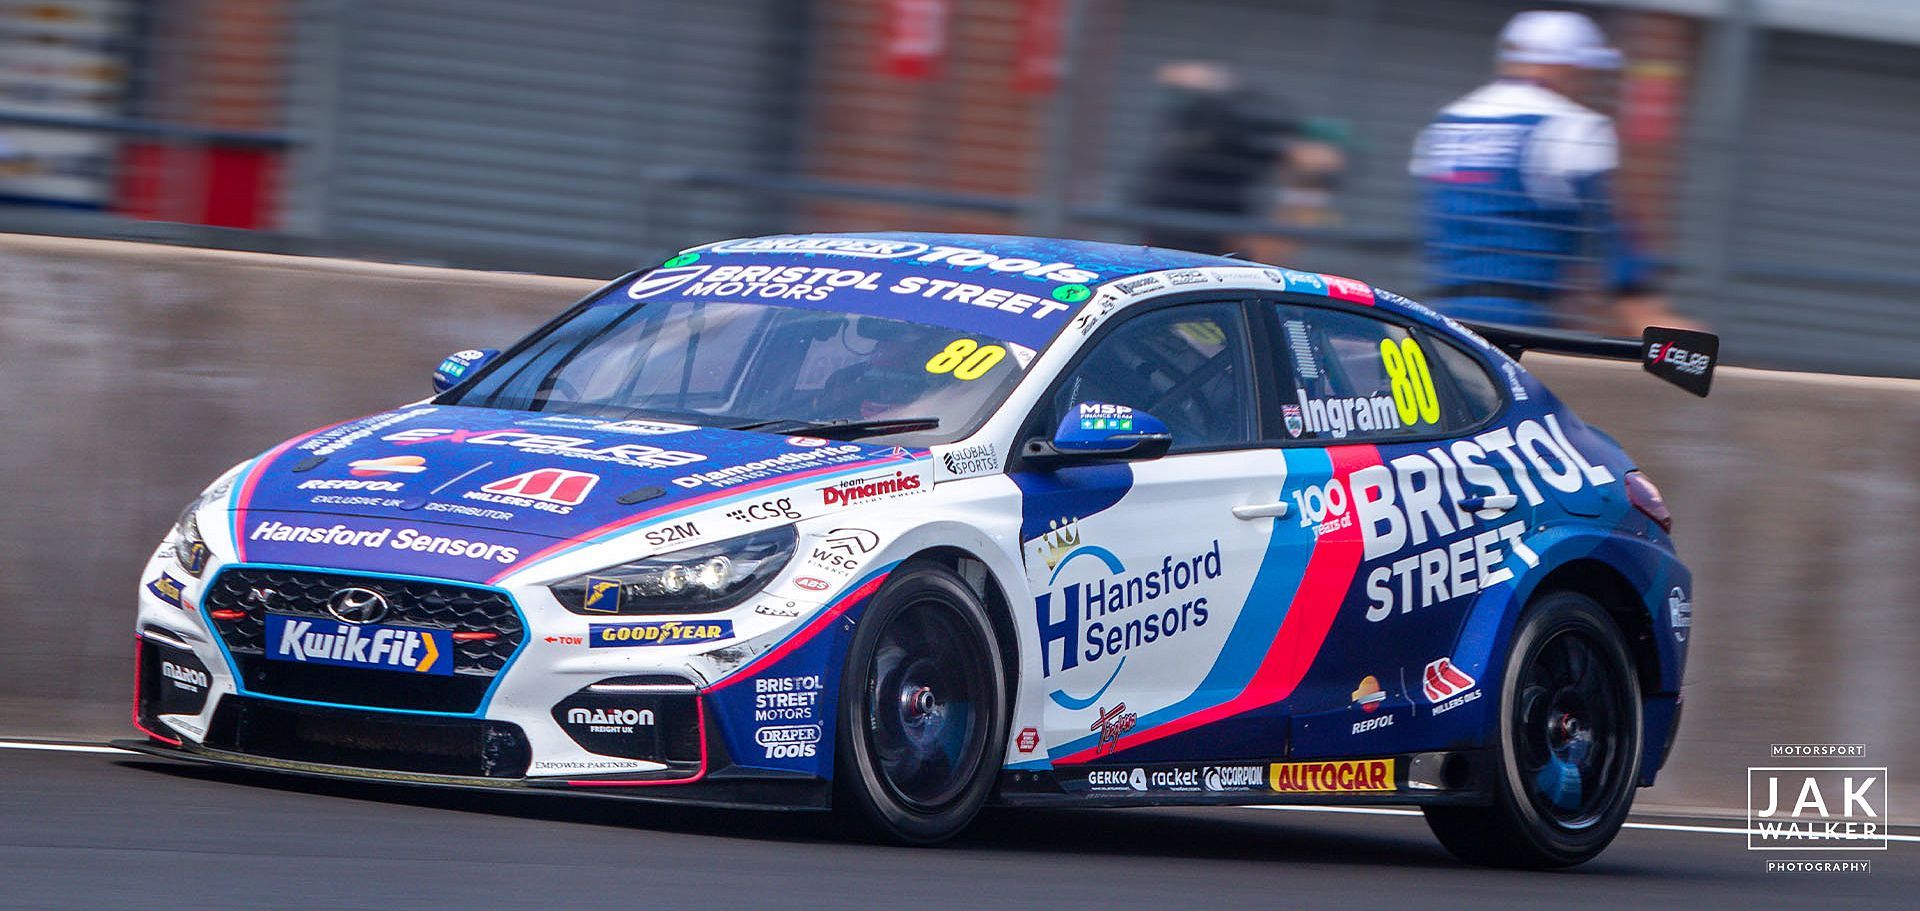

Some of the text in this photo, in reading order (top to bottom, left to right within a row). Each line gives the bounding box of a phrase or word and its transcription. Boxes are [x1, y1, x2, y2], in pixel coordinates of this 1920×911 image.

[917, 246, 1100, 283] Tools
[682, 282, 835, 302] MOTORS
[702, 265, 1070, 320] BRISTOL STREET
[925, 338, 1007, 381] 80
[1379, 337, 1441, 427] 80
[1080, 403, 1133, 414] MSP
[1296, 388, 1401, 439] Ingram
[952, 443, 992, 461] GLOBAL
[956, 458, 994, 475] SPORTS
[296, 479, 406, 492] REPSOL
[822, 471, 921, 507] Dynamics
[839, 478, 864, 488] team
[1348, 413, 1616, 562] BRISTOL
[310, 495, 382, 506] EXCLUSIVE
[424, 502, 515, 521] DISTRIBUTOR
[462, 491, 574, 516] MILLERS OILS
[747, 497, 802, 521] csg
[1291, 478, 1348, 528] 100
[644, 521, 702, 546] S2M
[1311, 518, 1341, 542] years
[250, 520, 520, 565] Hansford Sensors
[812, 548, 858, 570] WSC
[1085, 539, 1222, 621] Hansford
[1365, 520, 1540, 623] STREET
[559, 636, 583, 645] TOW
[602, 625, 722, 642] GOODYEAR
[1034, 582, 1081, 680] H
[1084, 596, 1210, 663] Sensors
[755, 675, 824, 693] BRISTOL
[755, 691, 818, 708] STREET
[1431, 688, 1483, 717] MILLERS OILS
[755, 707, 812, 722] MOTORS
[1351, 713, 1395, 735] REPSOL
[589, 726, 634, 734] FREIGHT UK
[761, 728, 817, 742] DRAPER
[763, 740, 817, 759] Tools
[535, 761, 639, 769] EMPOWER PARTNERS
[1151, 767, 1198, 786] rocket
[1220, 766, 1264, 786] SCORPION
[1278, 761, 1388, 791] AUTOCAR
[1088, 770, 1128, 785] GERKO
